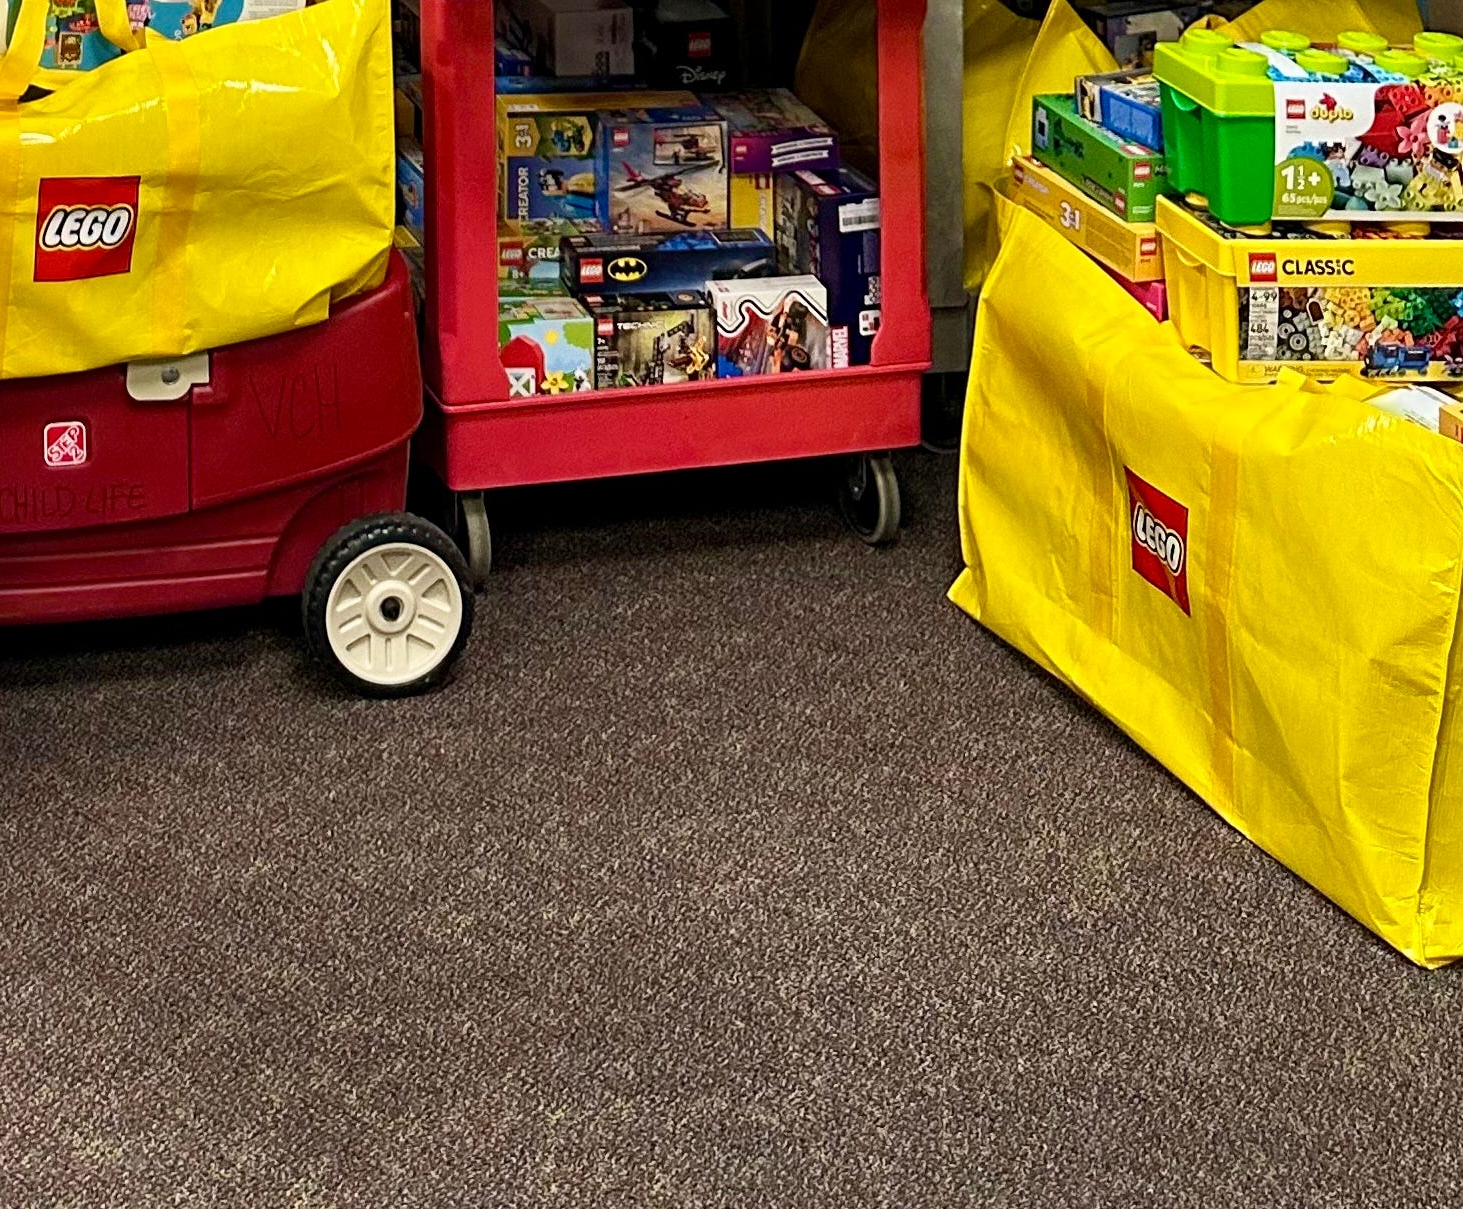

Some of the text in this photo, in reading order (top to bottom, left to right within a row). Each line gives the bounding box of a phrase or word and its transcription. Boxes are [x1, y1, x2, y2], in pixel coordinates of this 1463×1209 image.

[676, 65, 726, 85] Disney
[1311, 105, 1354, 124] duplo
[518, 167, 529, 221] REATOR
[1282, 193, 1295, 203] 65
[41, 206, 132, 249] LEGO
[528, 247, 560, 258] CREA
[581, 267, 603, 277] LEGO
[1251, 259, 1355, 275] LEGO CLASSIC
[1252, 292, 1277, 301] 4-99
[48, 425, 80, 462] STEP
[68, 445, 84, 461] 2
[85, 484, 146, 515] LIFE
[1135, 505, 1182, 573] LEGO
